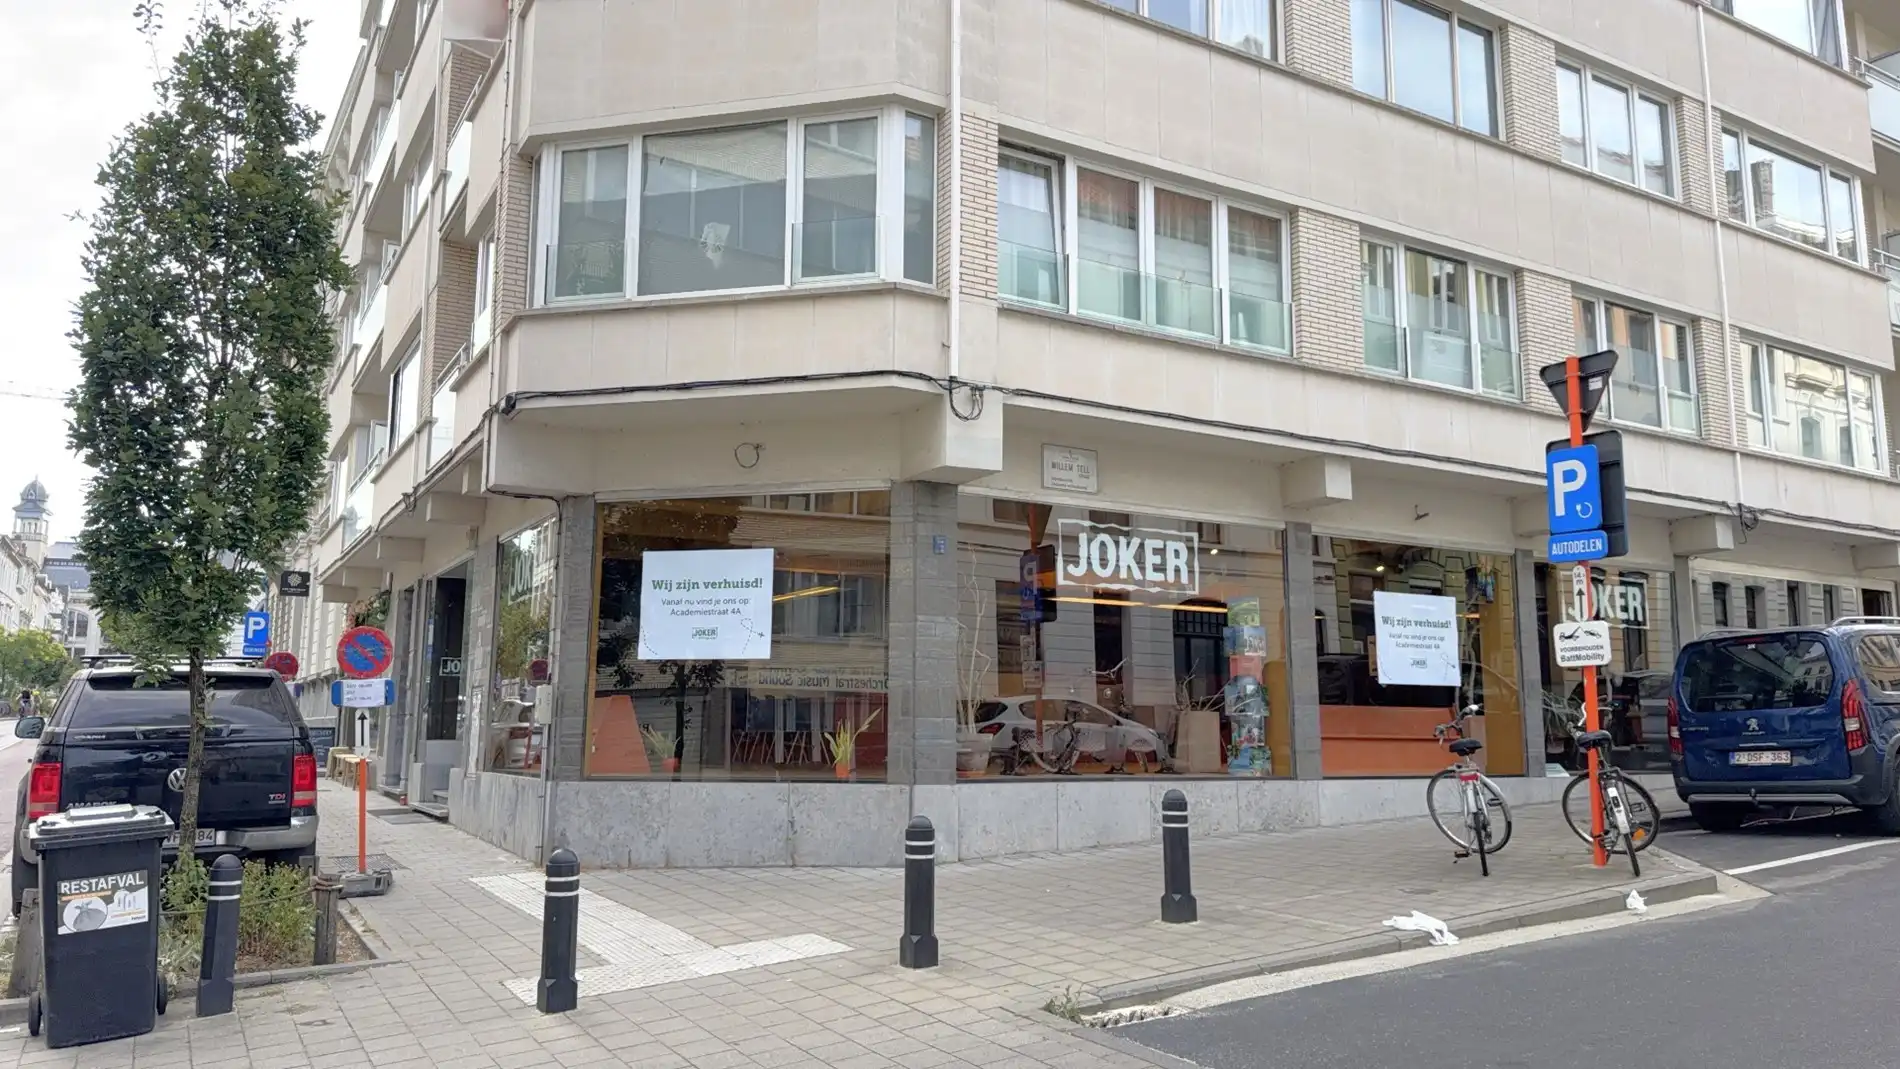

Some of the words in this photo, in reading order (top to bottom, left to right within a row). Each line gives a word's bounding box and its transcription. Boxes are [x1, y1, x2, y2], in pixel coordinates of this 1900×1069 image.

[1552, 459, 1587, 517] P
[1551, 538, 1603, 555] AUTODELEN
[1067, 532, 1189, 584] JOKER
[652, 580, 672, 592] Wij
[676, 579, 700, 592] zijn
[703, 578, 763, 590] verhuisd!
[661, 598, 682, 606] Vanaf
[696, 598, 713, 606] vind
[714, 598, 721, 607] je
[722, 598, 737, 606] ons
[670, 608, 729, 616] Academiestraat
[247, 616, 267, 639] P
[1382, 616, 1395, 628] Wij
[1396, 618, 1412, 629] zijn
[1414, 619, 1452, 628] verhuisd!
[694, 628, 716, 637] JOKER
[1560, 653, 1604, 662] BattMobility
[442, 659, 461, 673] JO
[60, 872, 144, 894] RESTAFVAL
